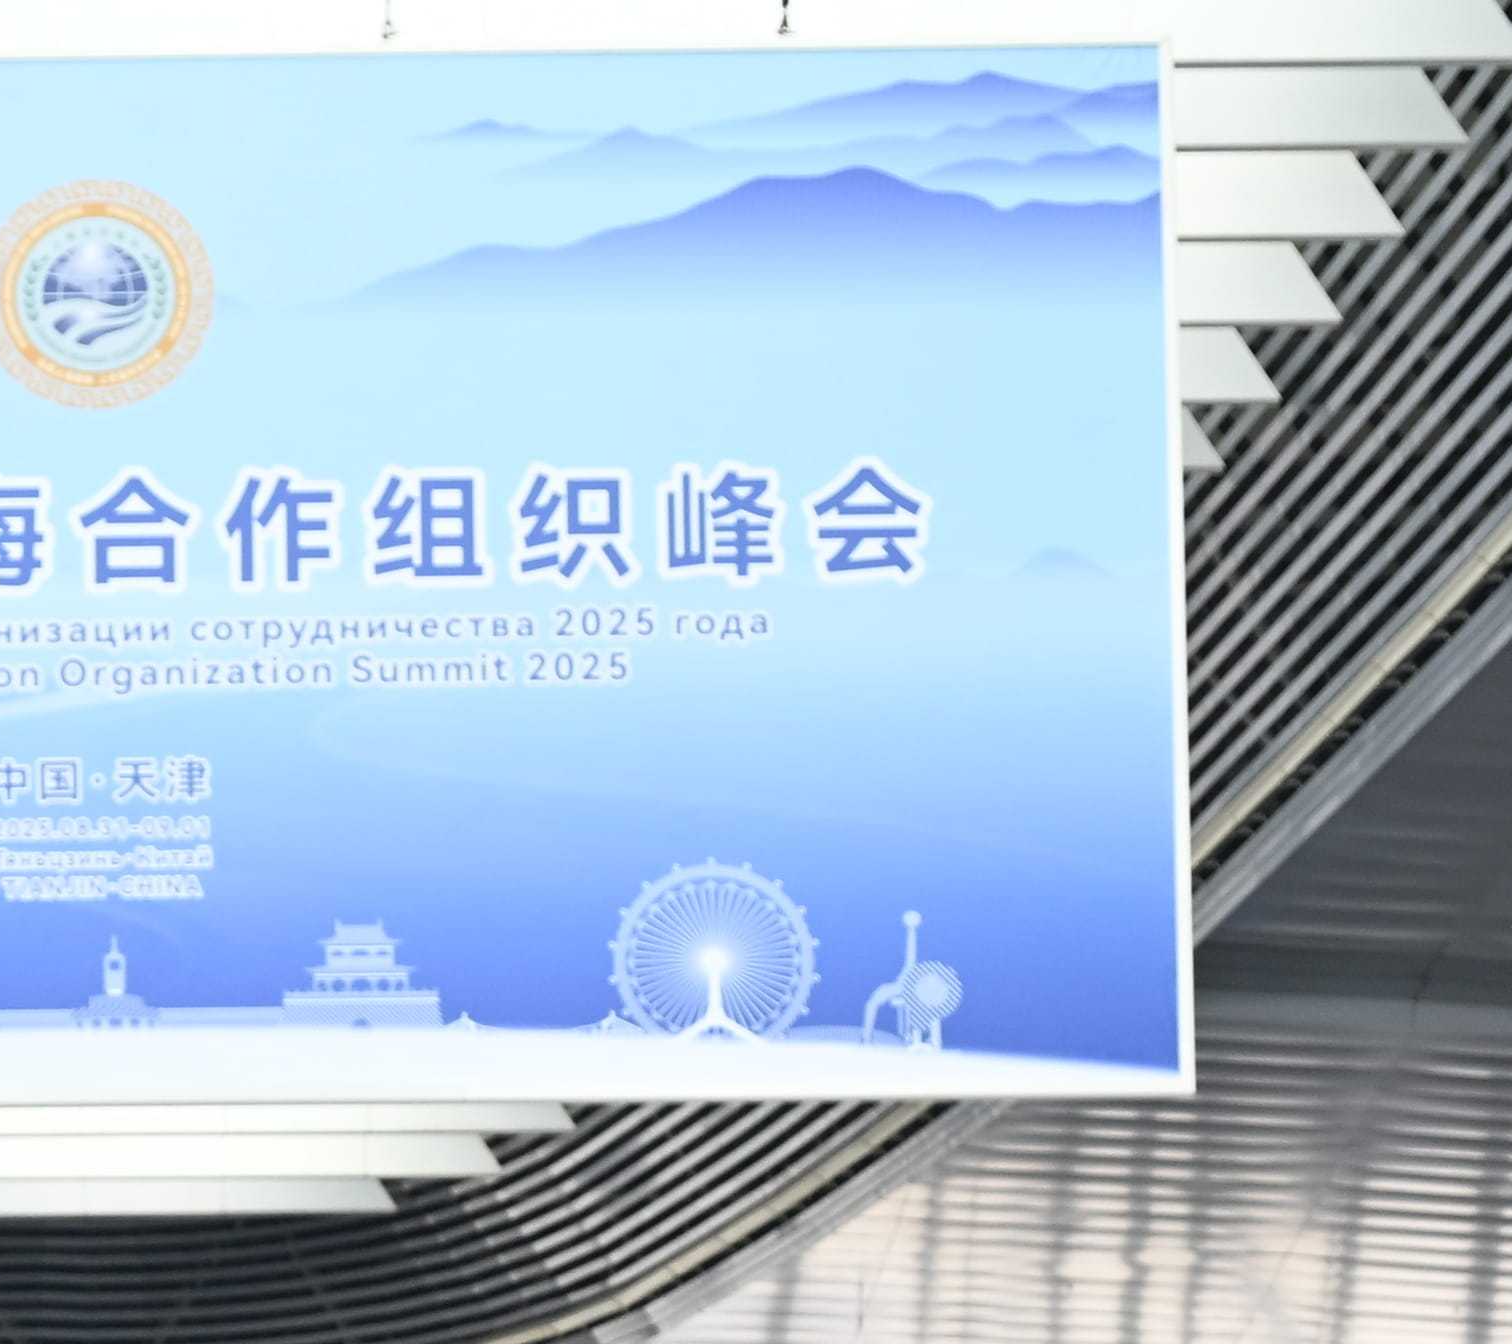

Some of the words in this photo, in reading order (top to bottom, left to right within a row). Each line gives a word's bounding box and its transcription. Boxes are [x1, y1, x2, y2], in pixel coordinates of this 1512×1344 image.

[191, 614, 536, 647] сотрудничества
[555, 609, 656, 637] 2025
[676, 612, 770, 639] года
[60, 657, 332, 693] Organization
[351, 654, 508, 685] Summit
[527, 653, 629, 681] 2025
